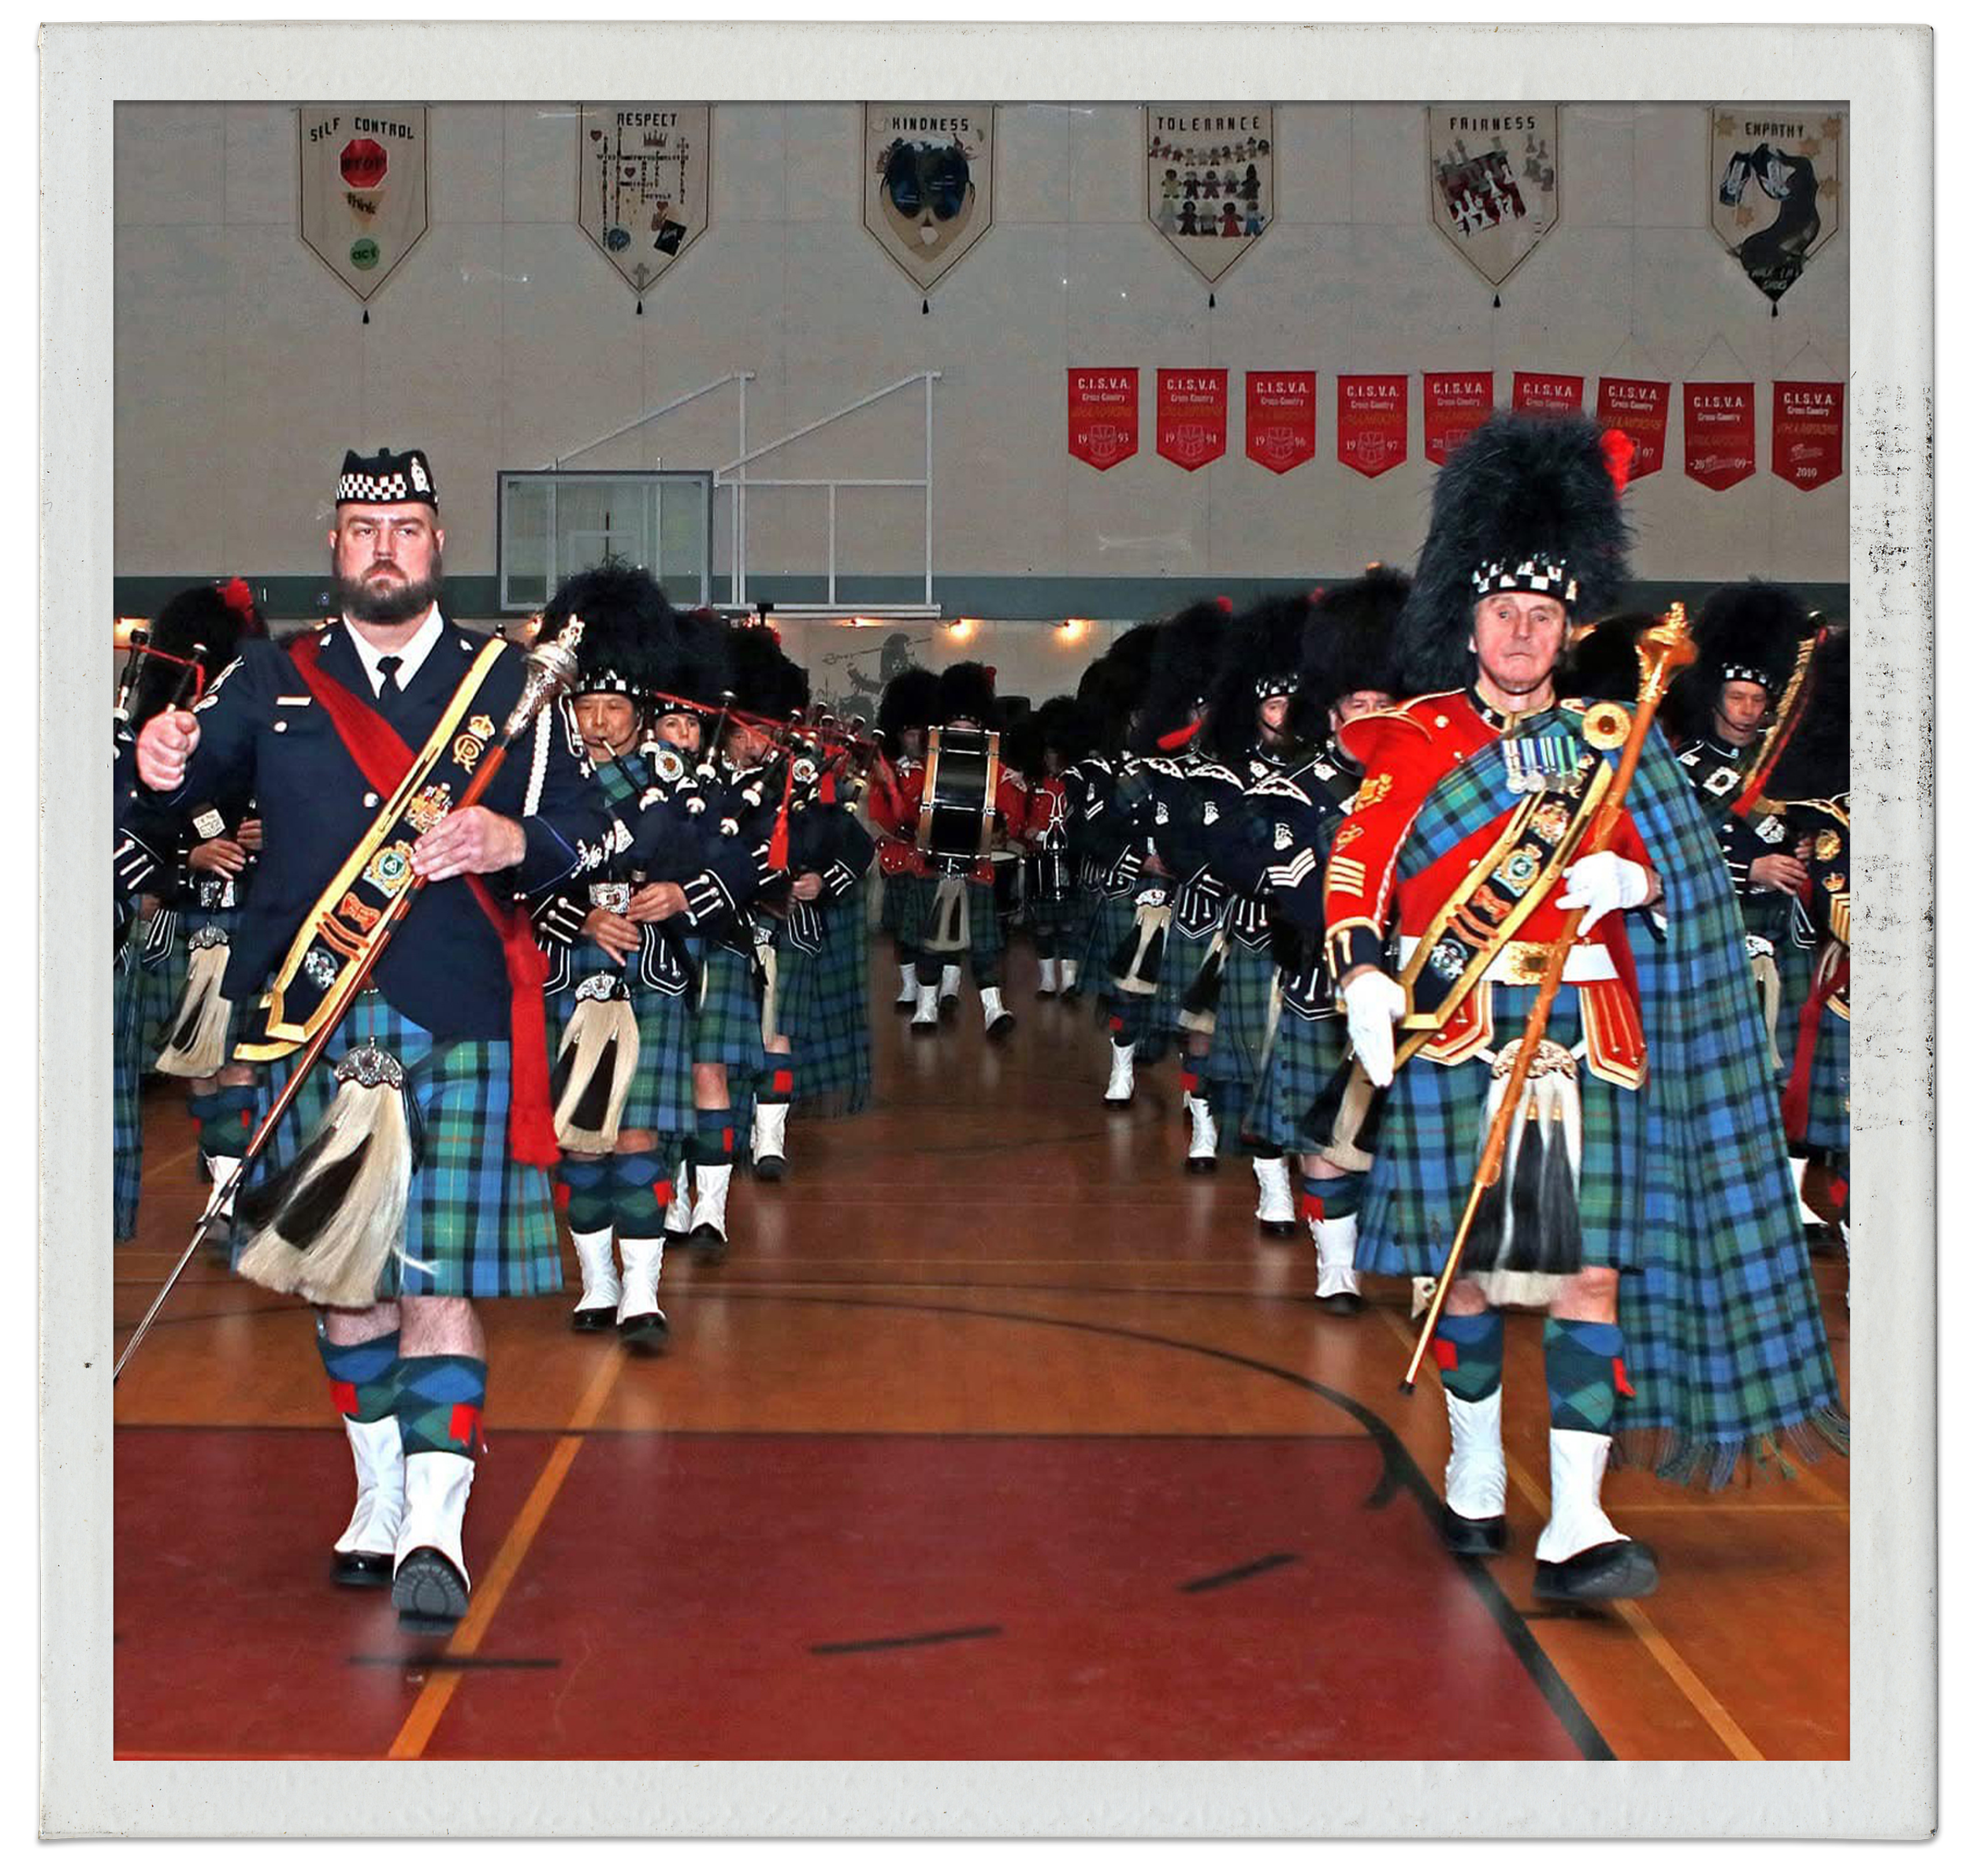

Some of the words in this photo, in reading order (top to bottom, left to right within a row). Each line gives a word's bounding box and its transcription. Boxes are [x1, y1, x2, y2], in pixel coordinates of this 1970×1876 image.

[617, 113, 678, 127] RESPECT
[892, 117, 969, 132] KINDNESS
[1157, 116, 1260, 132] TOLERANCE
[1450, 116, 1536, 132] FAIRNESS
[310, 117, 340, 142] SELF
[355, 117, 414, 140] CONTROL
[1744, 121, 1805, 138] EMPATHY
